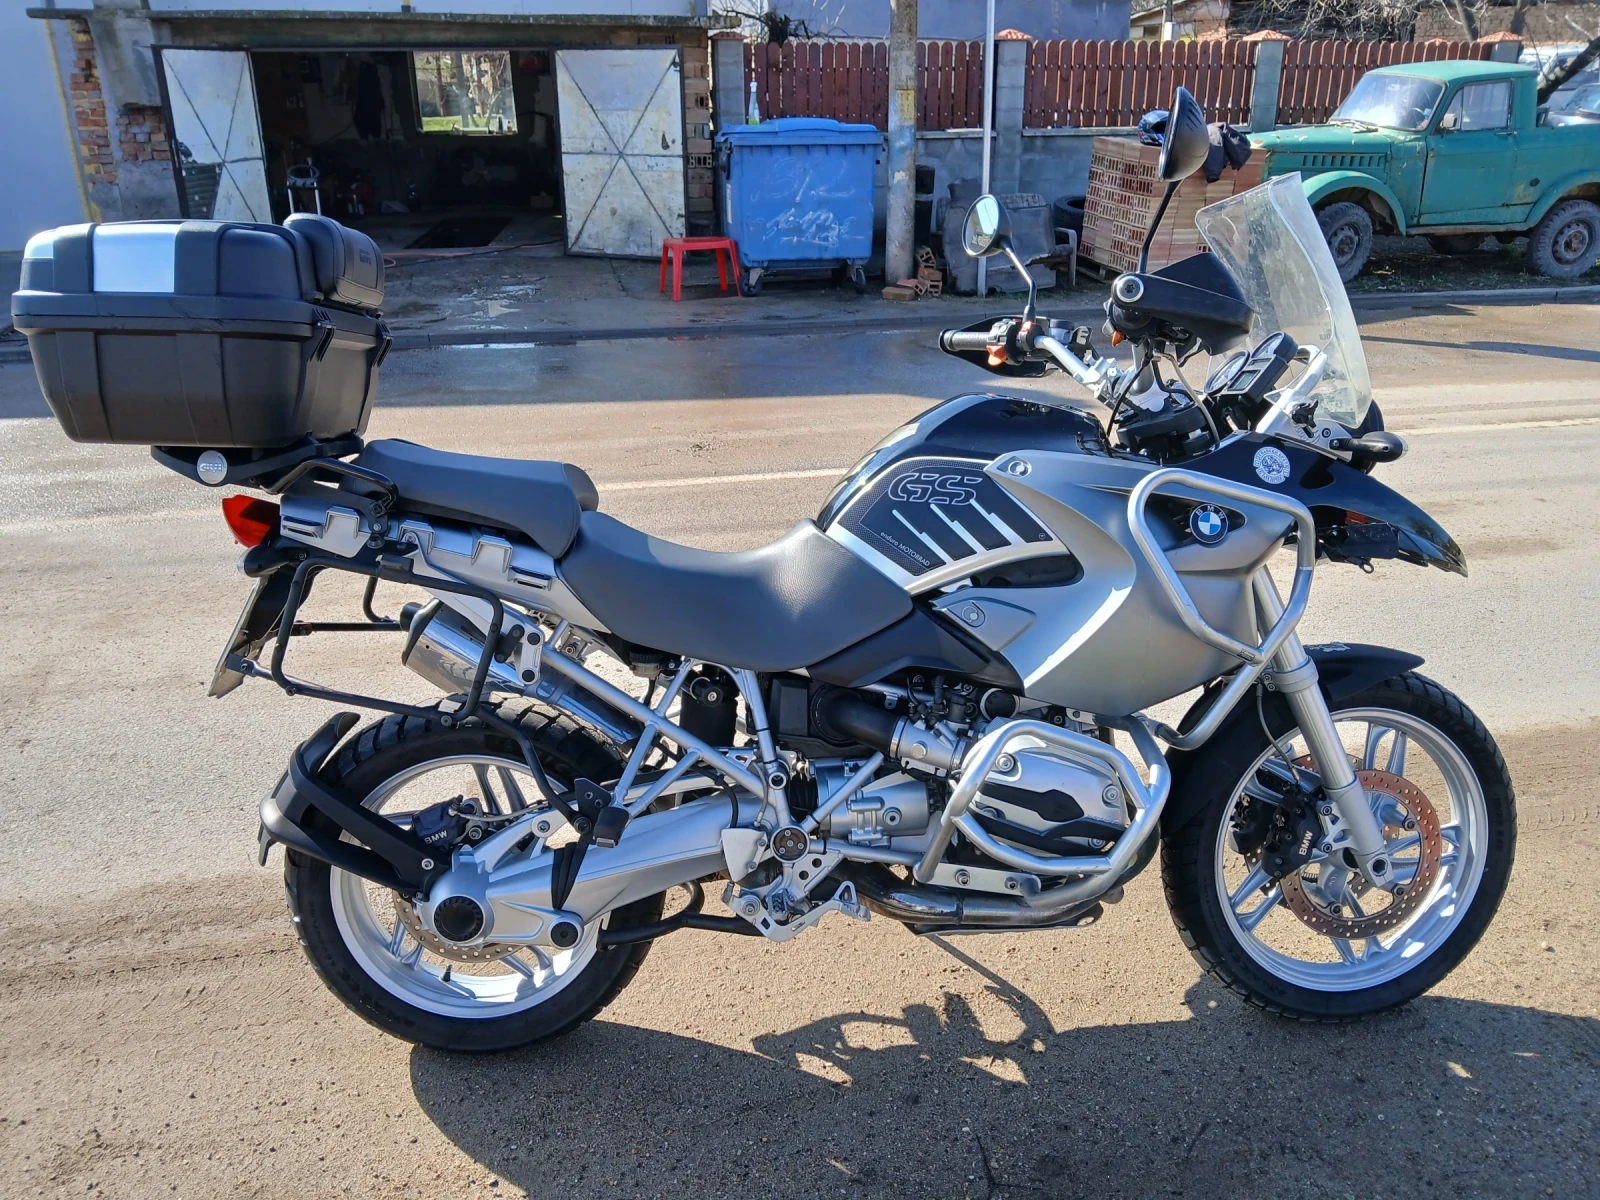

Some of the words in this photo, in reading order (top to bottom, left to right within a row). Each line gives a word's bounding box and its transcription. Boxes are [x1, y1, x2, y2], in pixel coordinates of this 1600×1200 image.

[888, 472, 983, 506] GS
[1196, 506, 1226, 520] BMW
[880, 531, 898, 546] enduro
[898, 543, 932, 567] MOTORRAD
[424, 829, 448, 845] BMW
[1299, 830, 1314, 856] BMW
